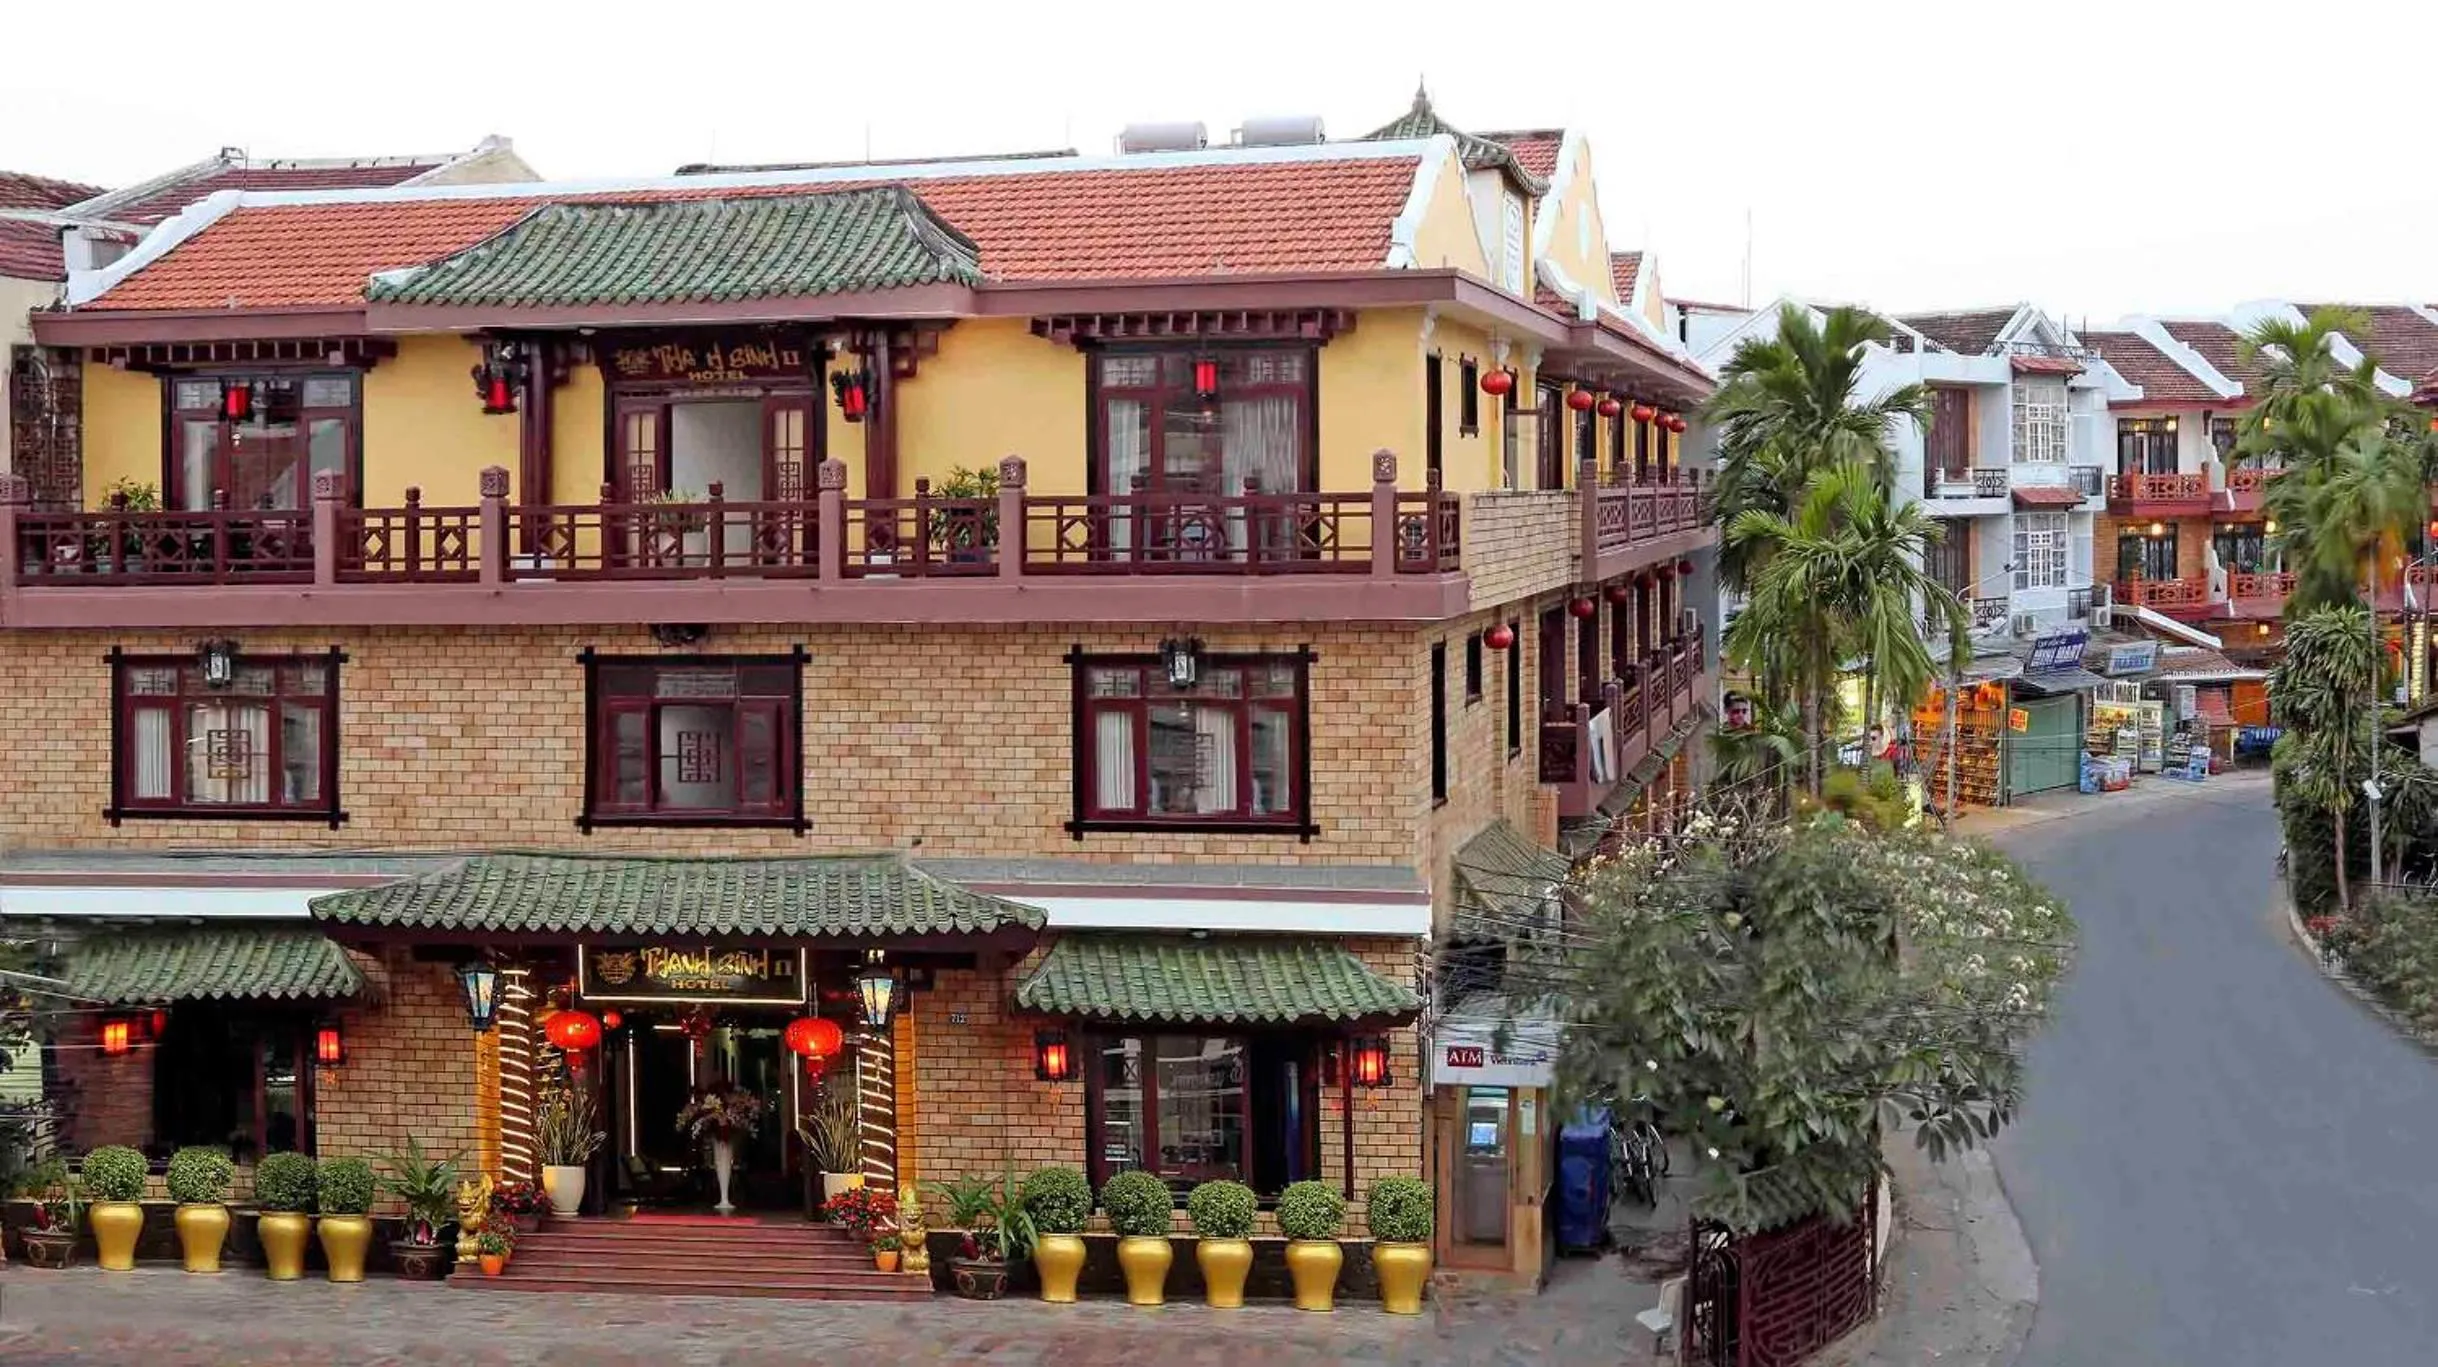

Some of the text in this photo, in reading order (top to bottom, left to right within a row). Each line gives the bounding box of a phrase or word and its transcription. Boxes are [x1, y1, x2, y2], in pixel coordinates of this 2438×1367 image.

[652, 341, 724, 373] THAH
[688, 370, 748, 382] HOTEL
[2055, 643, 2083, 663] MART
[640, 946, 714, 978] THANH
[671, 979, 730, 990] HOTEL
[1449, 1051, 1482, 1064] ATM
